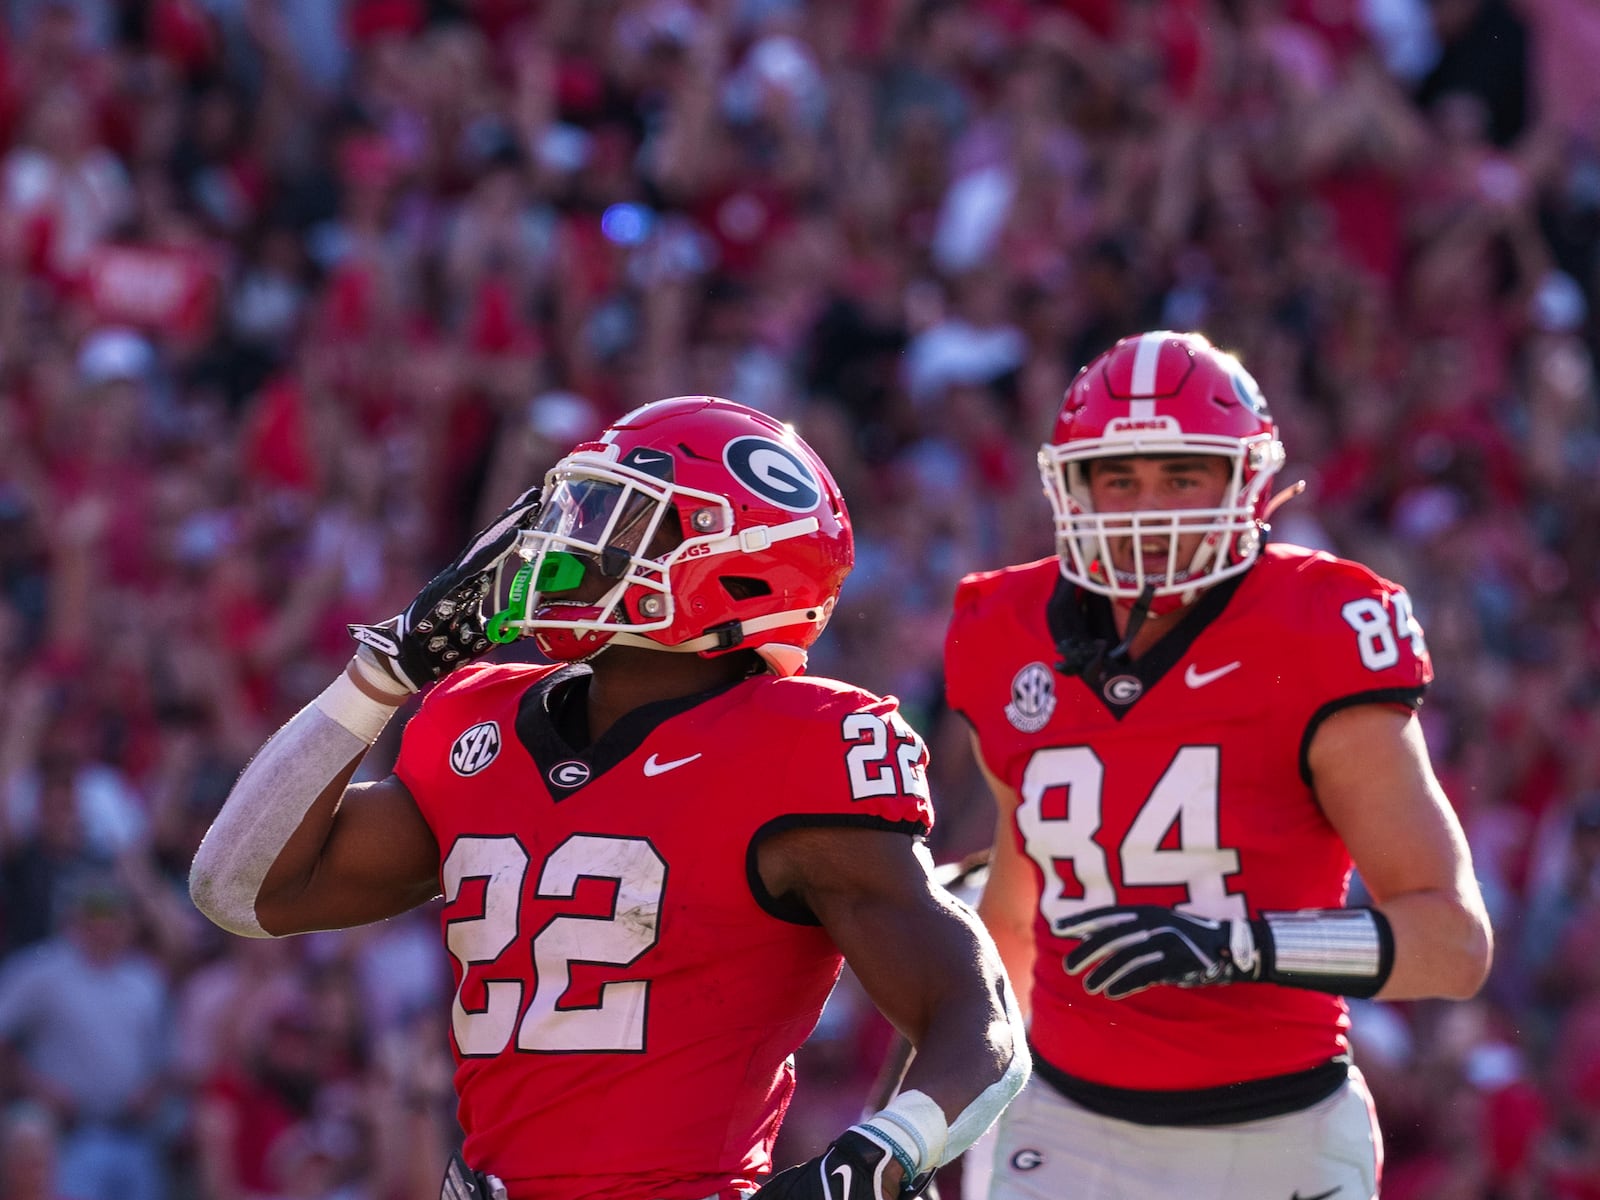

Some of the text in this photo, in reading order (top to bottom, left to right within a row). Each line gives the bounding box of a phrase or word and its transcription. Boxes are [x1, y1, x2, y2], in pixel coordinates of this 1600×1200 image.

[1340, 590, 1425, 672] 84
[452, 723, 498, 774] SEC
[841, 712, 927, 802] 22
[1017, 745, 1247, 938] 84
[443, 833, 669, 1058] 22
